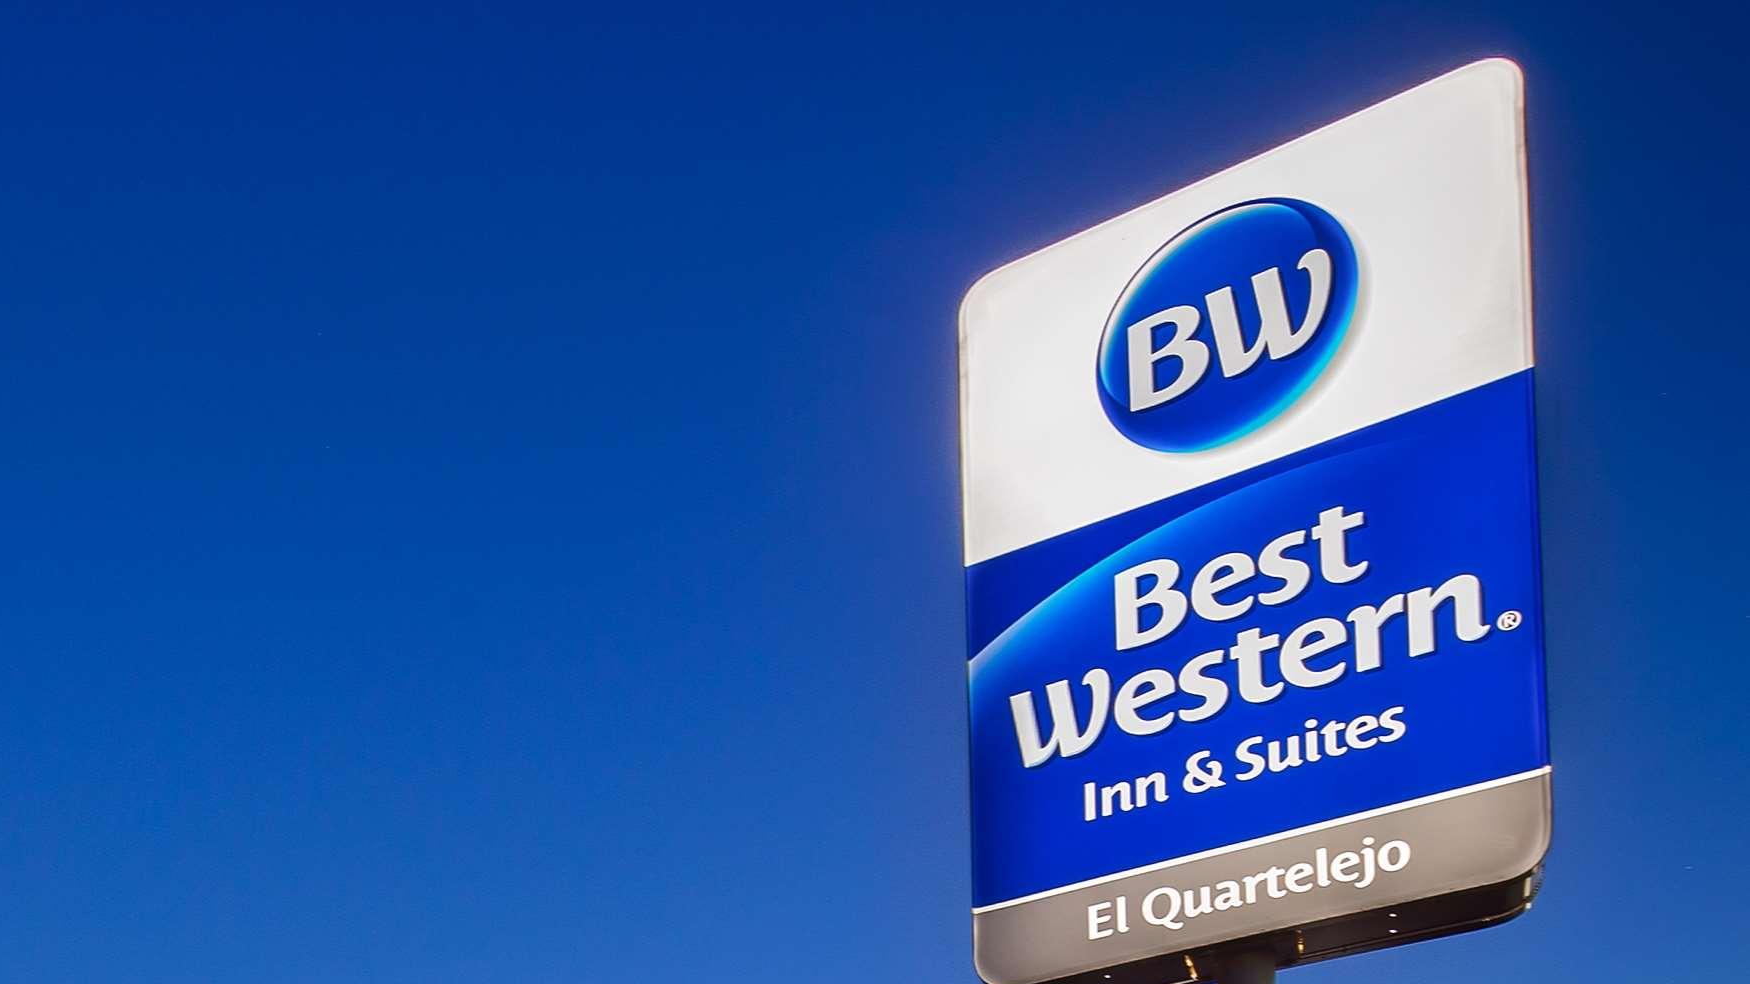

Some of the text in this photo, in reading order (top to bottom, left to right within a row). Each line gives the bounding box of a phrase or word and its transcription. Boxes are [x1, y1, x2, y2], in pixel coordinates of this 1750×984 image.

[1128, 248, 1331, 412] BW
[1114, 506, 1368, 651] Best
[1084, 706, 1406, 821] Inn & Suites
[1087, 836, 1412, 940] El Quartelejo
